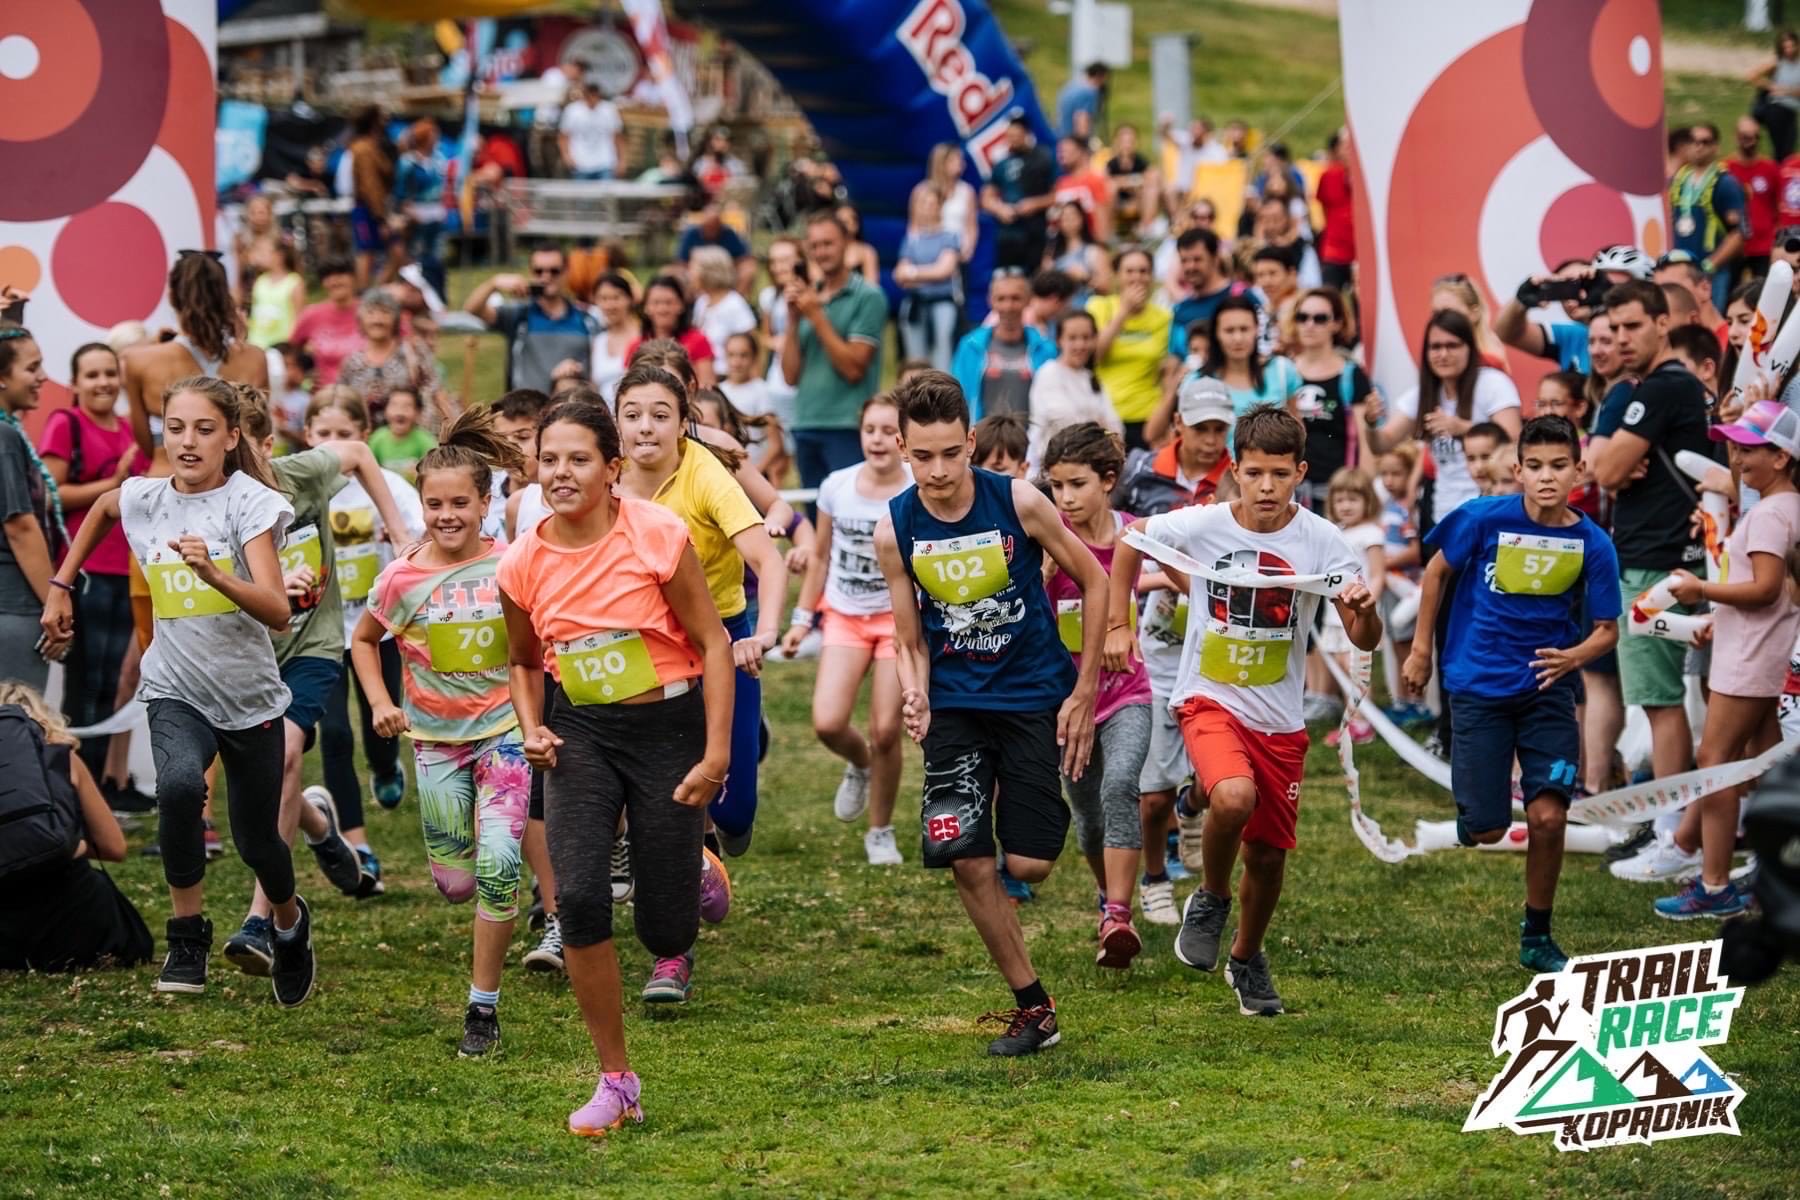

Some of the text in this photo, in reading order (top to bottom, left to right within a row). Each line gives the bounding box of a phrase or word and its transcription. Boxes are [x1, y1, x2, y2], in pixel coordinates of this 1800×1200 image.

[897, 0, 1014, 138] Red
[933, 556, 986, 582] 102
[1523, 554, 1557, 575] 57
[458, 626, 495, 650] 70
[950, 631, 1012, 653] Vintage
[574, 651, 626, 682] 120
[1227, 644, 1267, 666] 121
